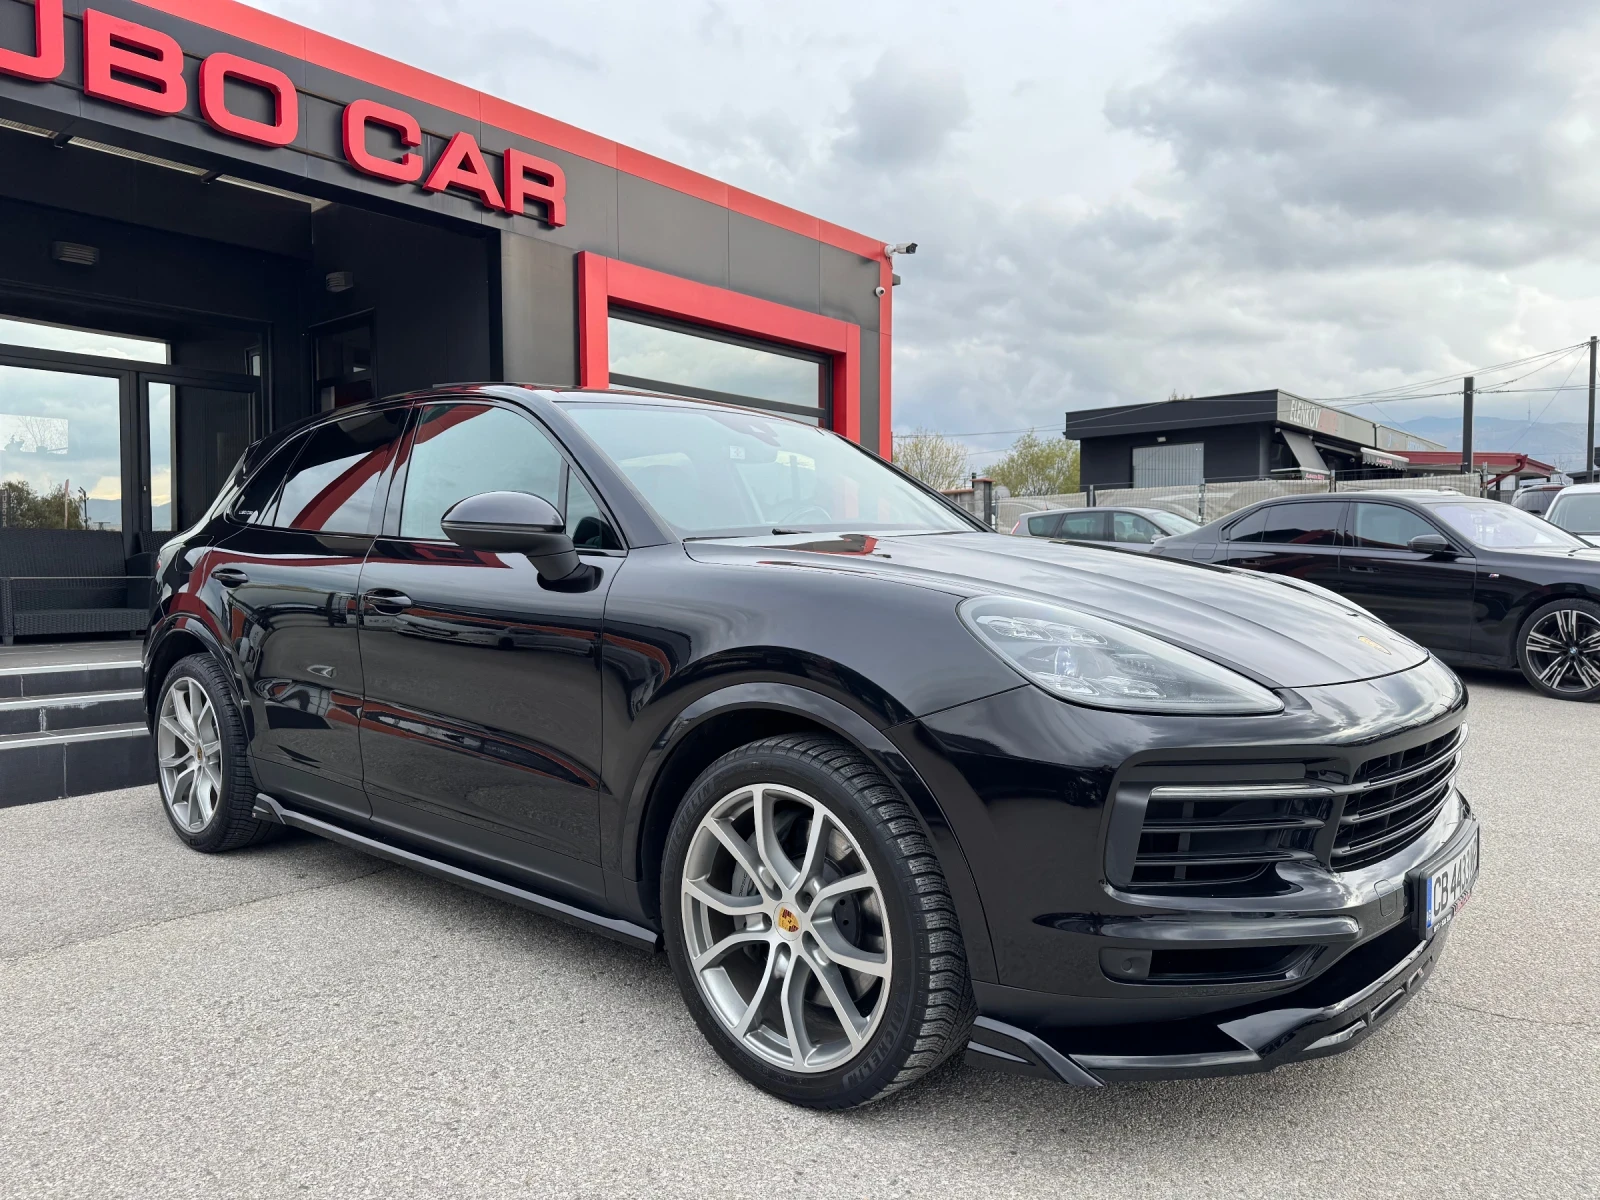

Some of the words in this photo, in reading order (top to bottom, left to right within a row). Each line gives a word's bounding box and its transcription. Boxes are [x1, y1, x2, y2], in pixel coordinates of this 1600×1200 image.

[342, 98, 568, 229] CAR
[1289, 399, 1322, 429] ELENKOV
[1433, 872, 1449, 917] CB
[846, 1000, 906, 1087] MICHELIN
